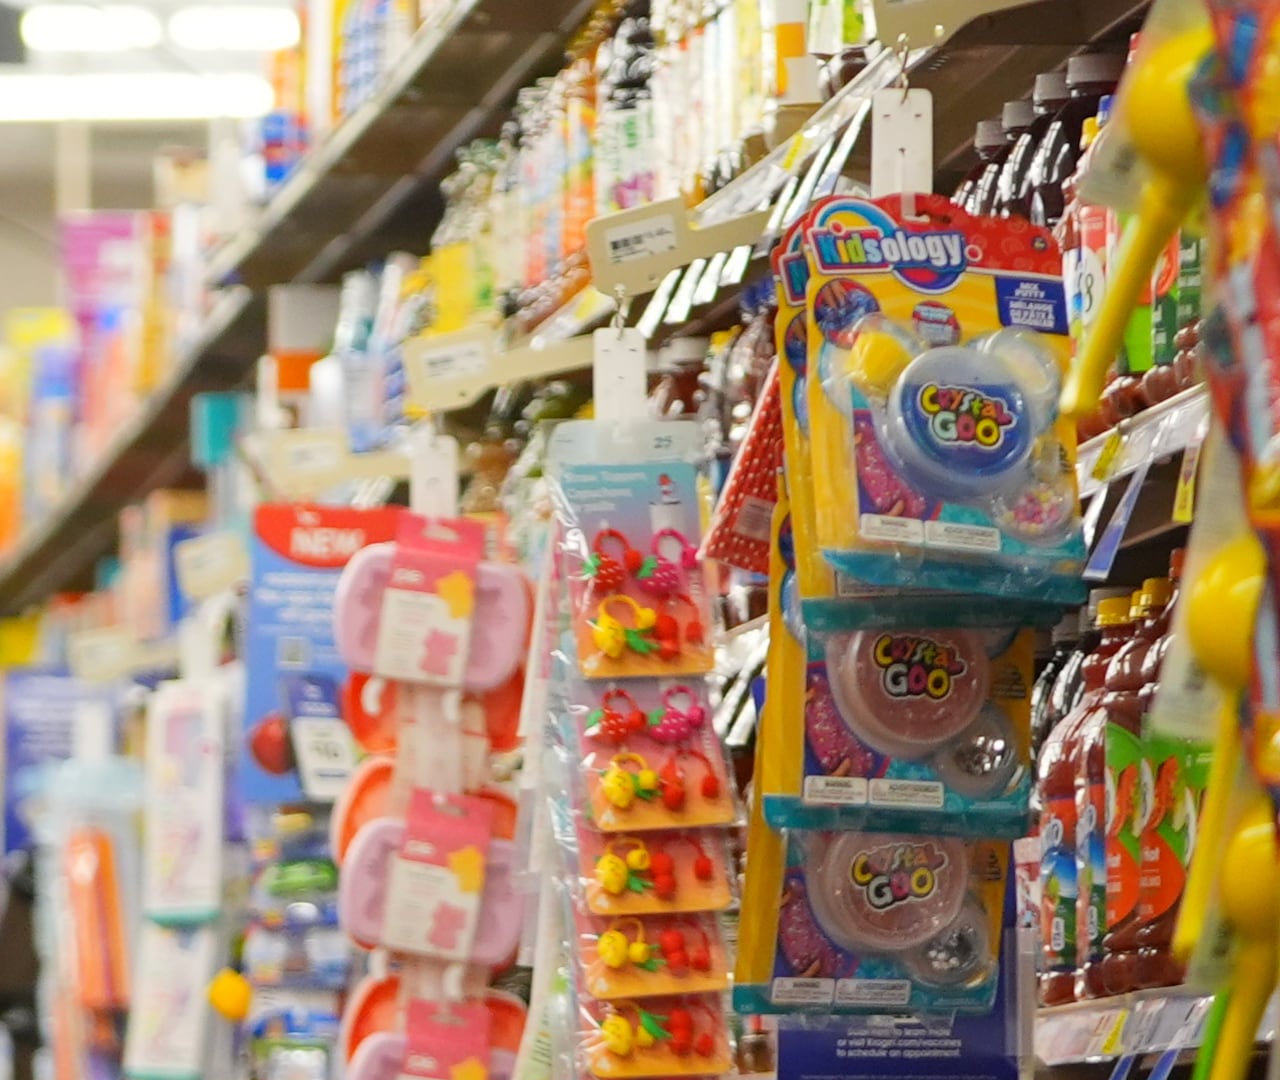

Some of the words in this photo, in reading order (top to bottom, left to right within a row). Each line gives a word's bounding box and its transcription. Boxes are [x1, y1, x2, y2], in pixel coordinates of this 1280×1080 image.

[816, 222, 966, 268] Kidsology
[933, 411, 1000, 446] GOO
[884, 662, 950, 698] GOO
